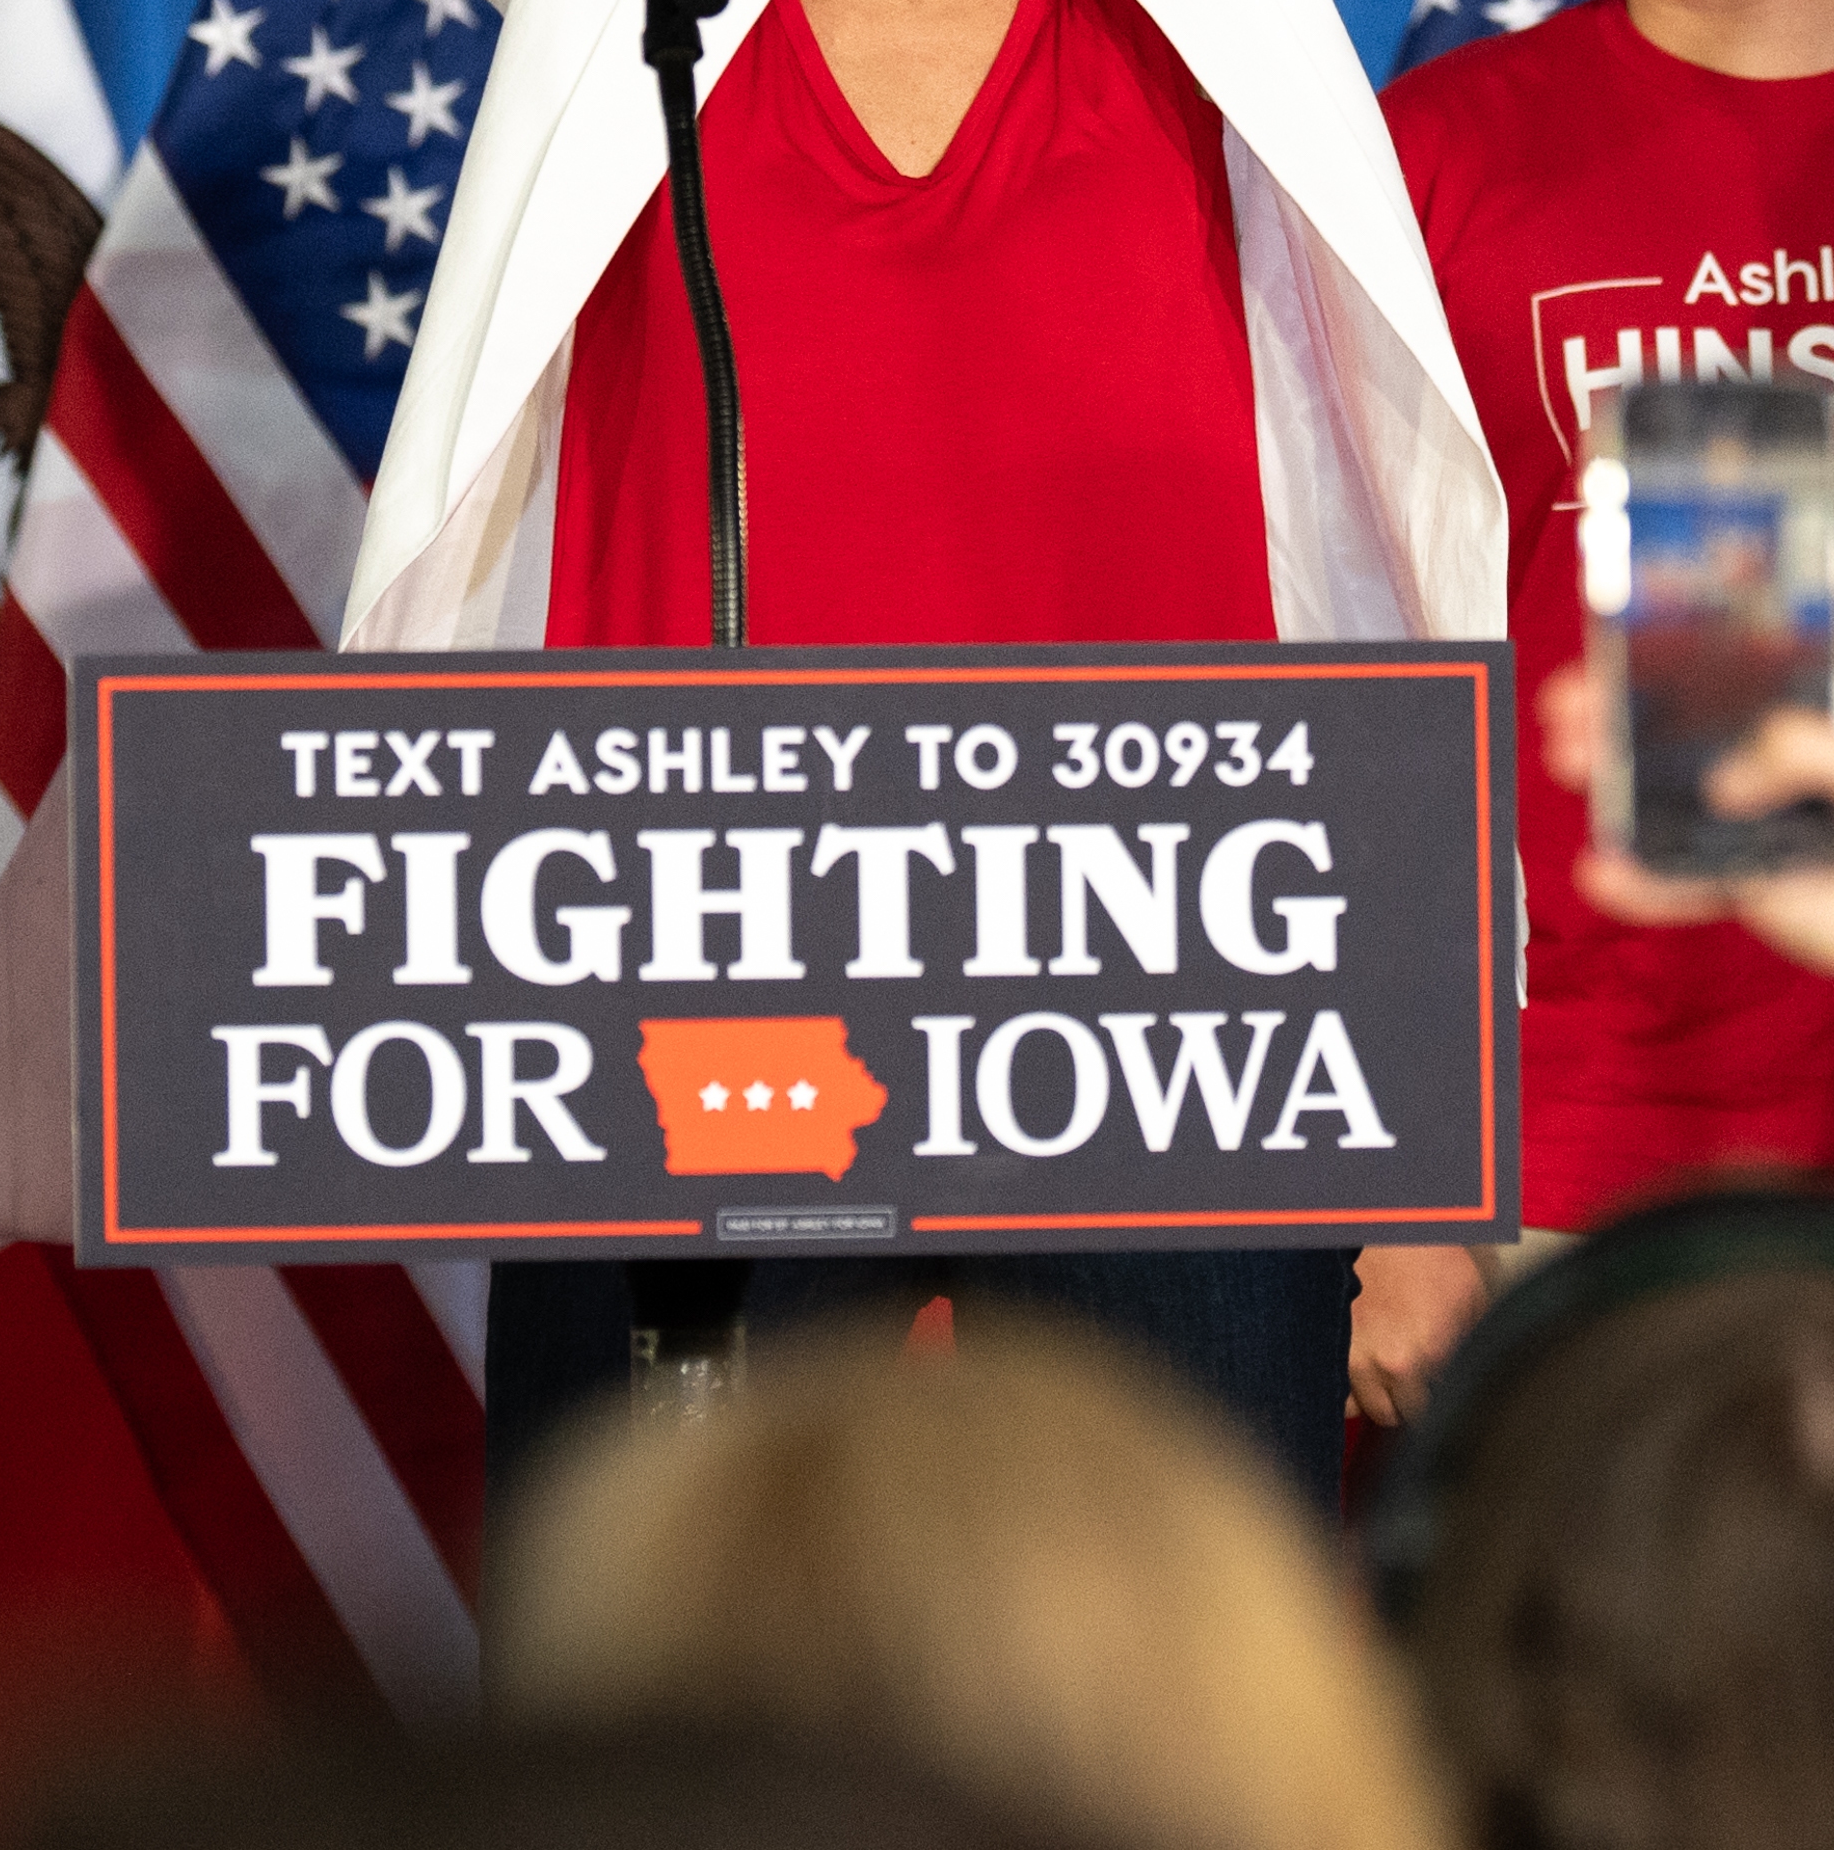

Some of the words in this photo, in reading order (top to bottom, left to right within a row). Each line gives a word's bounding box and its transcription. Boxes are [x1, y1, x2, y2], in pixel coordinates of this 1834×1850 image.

[279, 728, 496, 798] TEXT
[527, 725, 872, 796] ASHLEY
[904, 723, 1019, 791] TO
[1051, 720, 1315, 790] 30934
[249, 818, 1348, 988] FIGHTING
[210, 1020, 607, 1168] FOR
[910, 1009, 1397, 1158] IOWA
